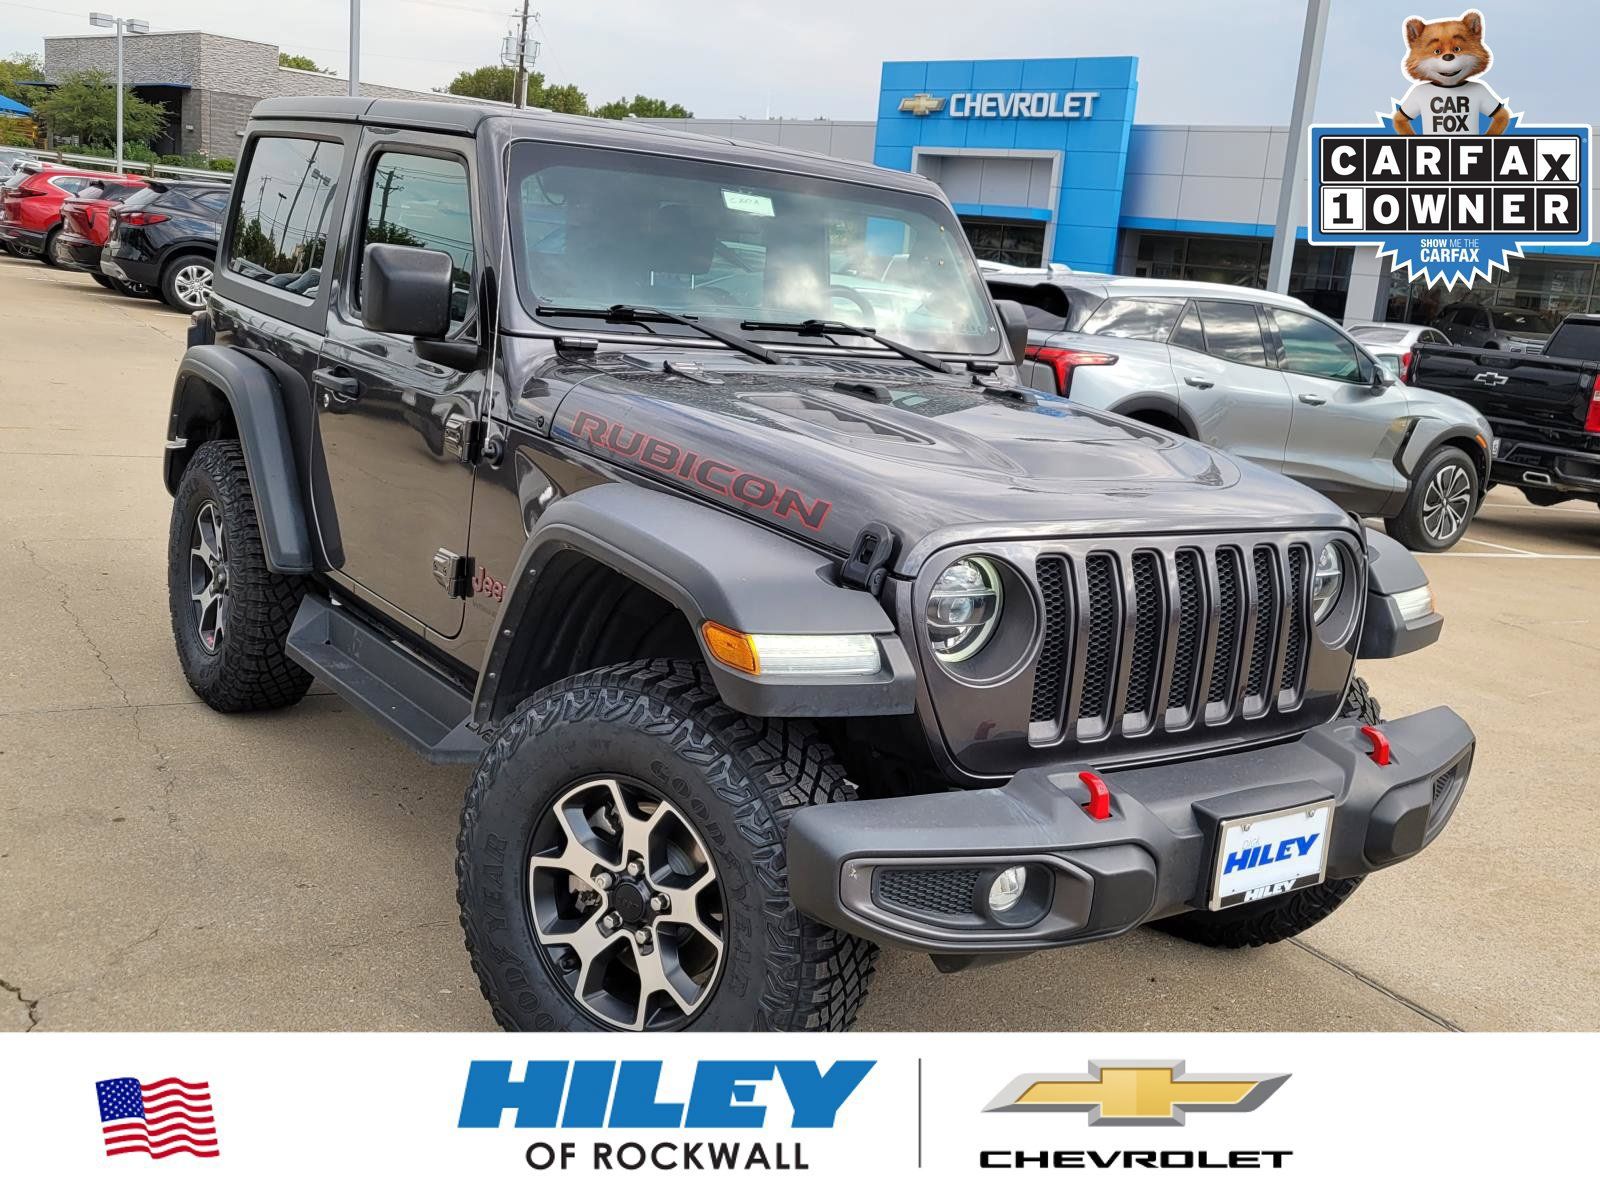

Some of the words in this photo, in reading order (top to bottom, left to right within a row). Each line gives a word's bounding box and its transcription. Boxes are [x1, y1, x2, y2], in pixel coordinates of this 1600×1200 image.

[950, 91, 1100, 119] CHEVROLET
[570, 410, 833, 533] RUBICON
[1223, 833, 1320, 875] HILEY
[1243, 878, 1297, 902] HILEY
